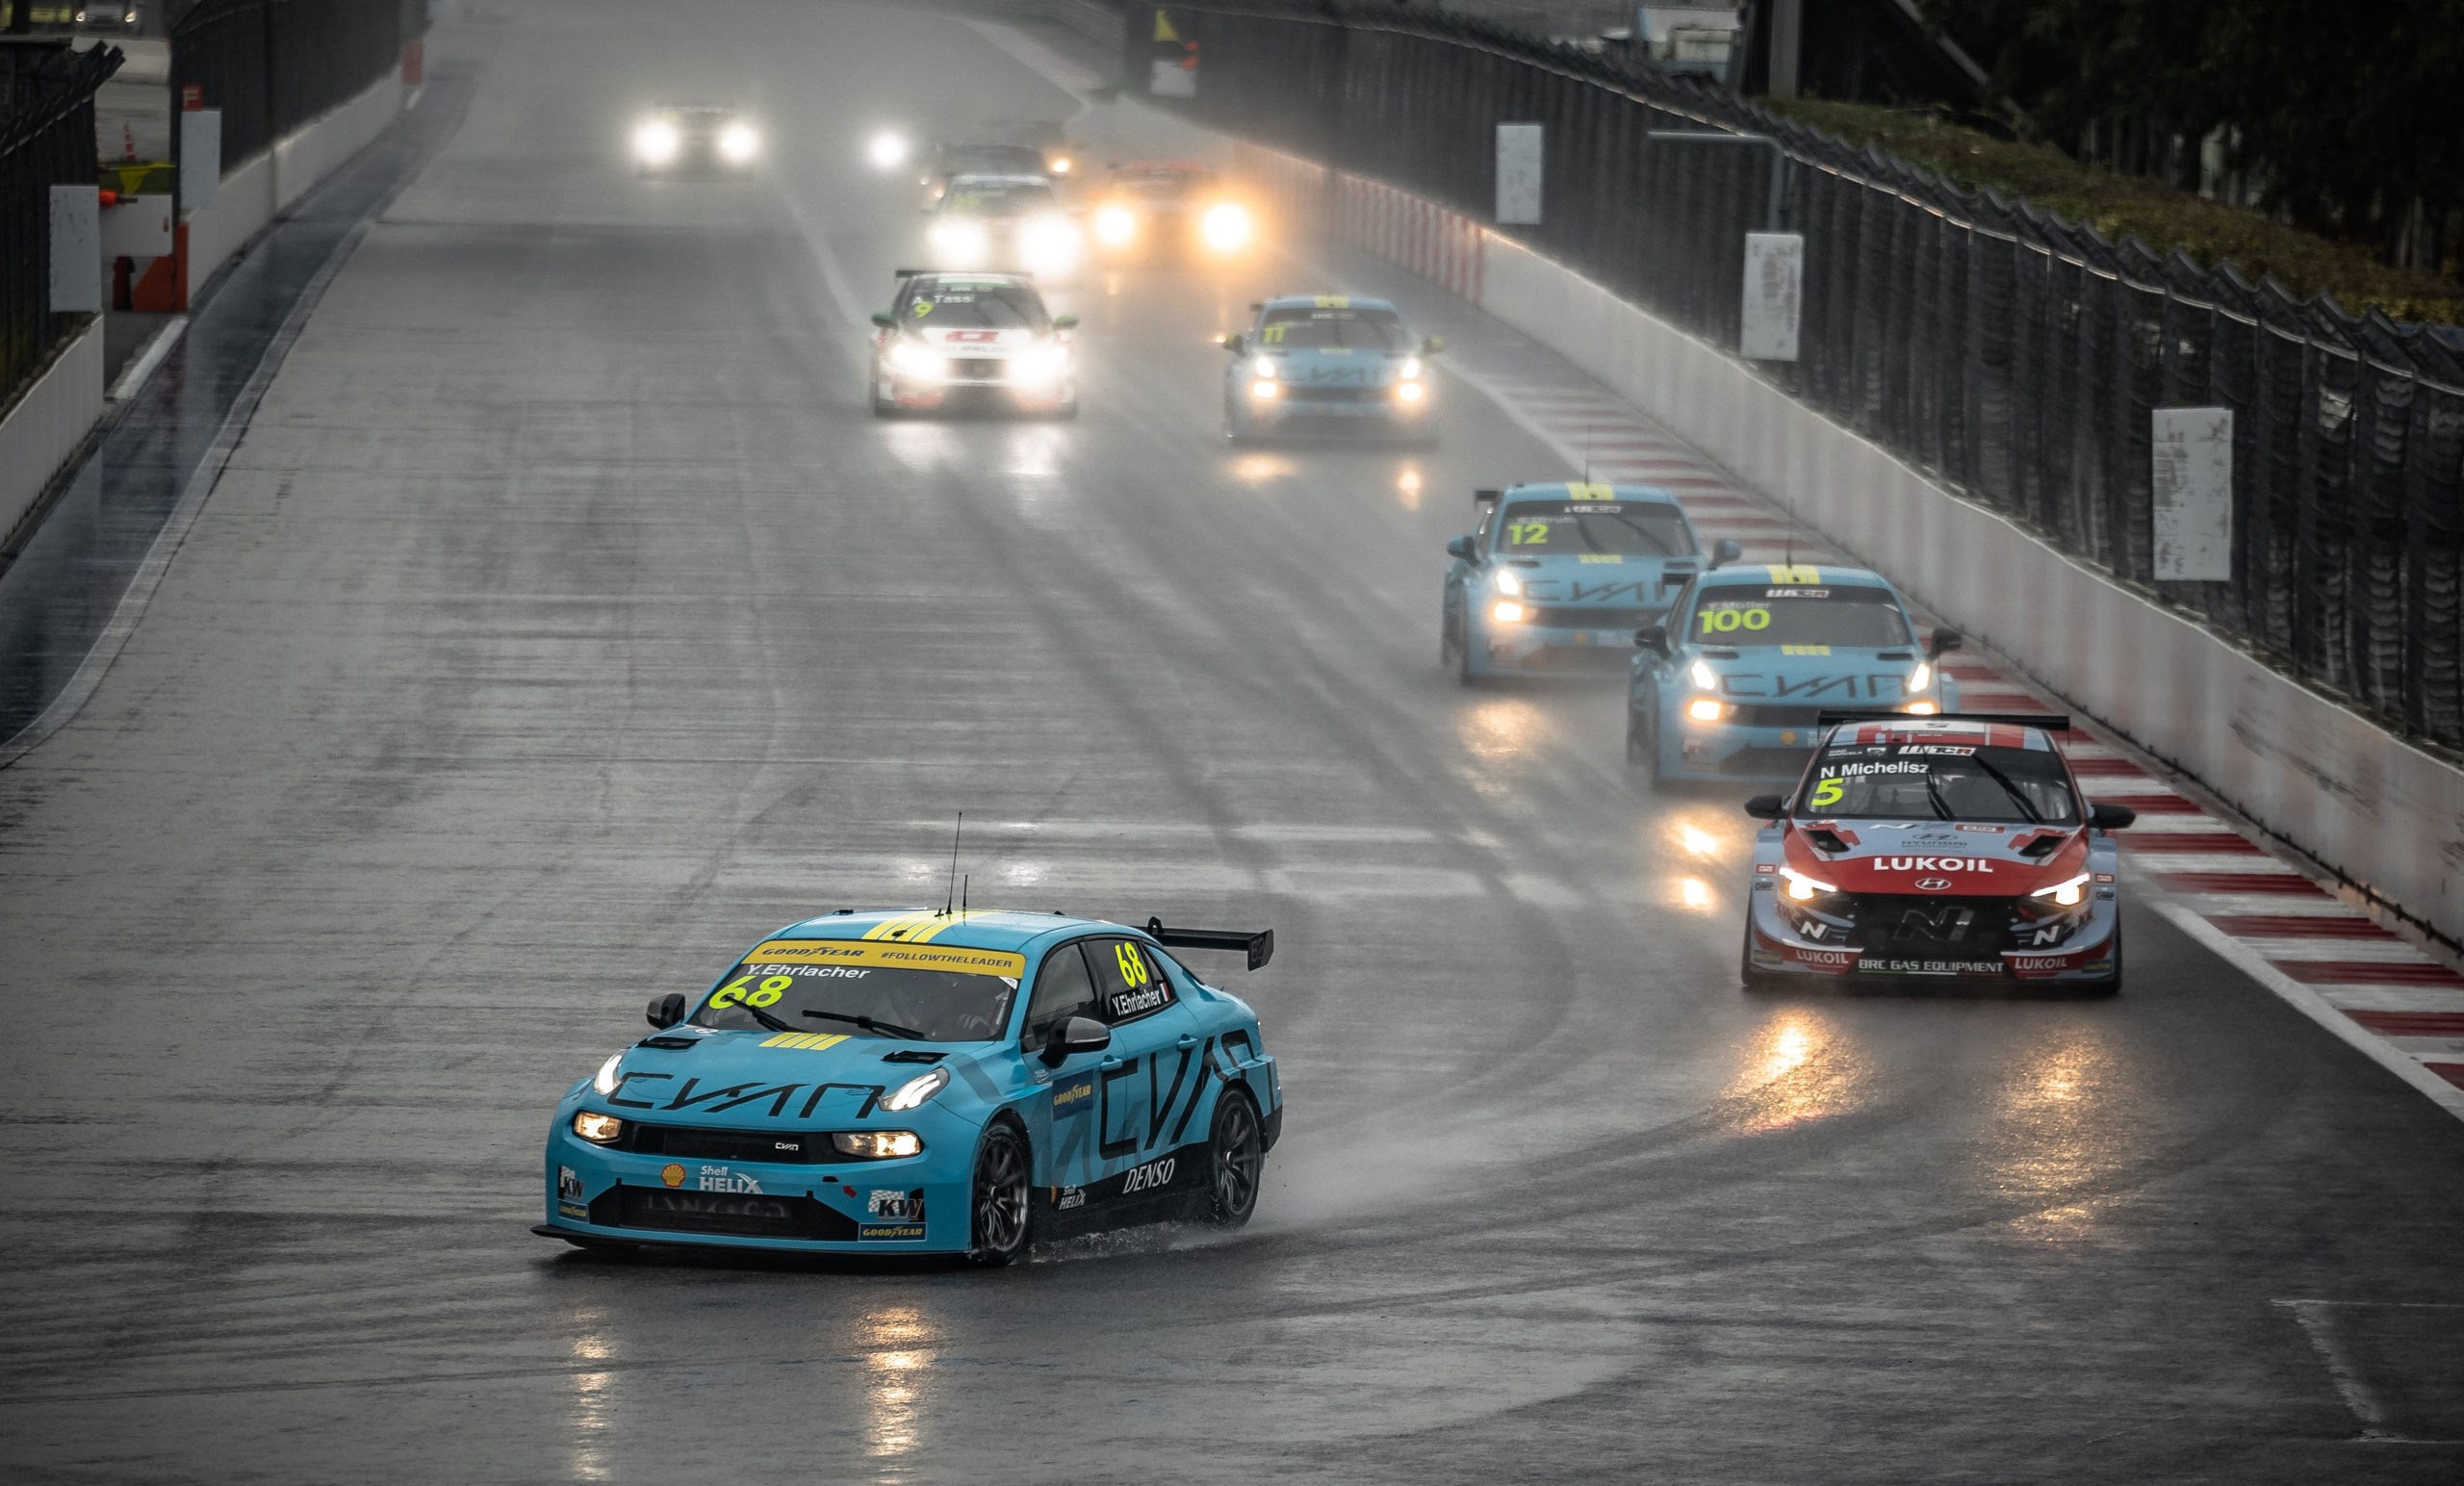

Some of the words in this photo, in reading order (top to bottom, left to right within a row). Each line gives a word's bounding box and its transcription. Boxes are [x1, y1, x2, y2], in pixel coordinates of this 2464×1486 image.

[1507, 523, 1549, 545] 12
[1697, 608, 1770, 634] 100
[1841, 761, 1930, 777] Michelisz
[1811, 778, 1844, 807] 5
[1874, 858, 1993, 873] LUKOIL
[762, 946, 864, 958] GOODYEAR
[881, 952, 1013, 968] #FOLLOWTHELEADER
[1115, 941, 1147, 987] 68
[1795, 950, 1849, 964] LUKOIL
[1859, 959, 1886, 969] BRC
[1890, 961, 1919, 970] GAS
[1923, 961, 2004, 972] EQUIPMENT
[2015, 958, 2067, 969] LUKOIL
[747, 964, 871, 979] Y.Ehrlacher
[708, 975, 793, 1010] 68
[1112, 989, 1161, 1016] Y.Ehrlacher
[701, 1166, 729, 1176] Shell
[1122, 1158, 1175, 1194] DENSO
[699, 1172, 763, 1194] HELIX
[877, 1198, 924, 1218] KW
[1059, 1189, 1087, 1211] HELIX
[862, 1225, 923, 1237] GOODYEAR
